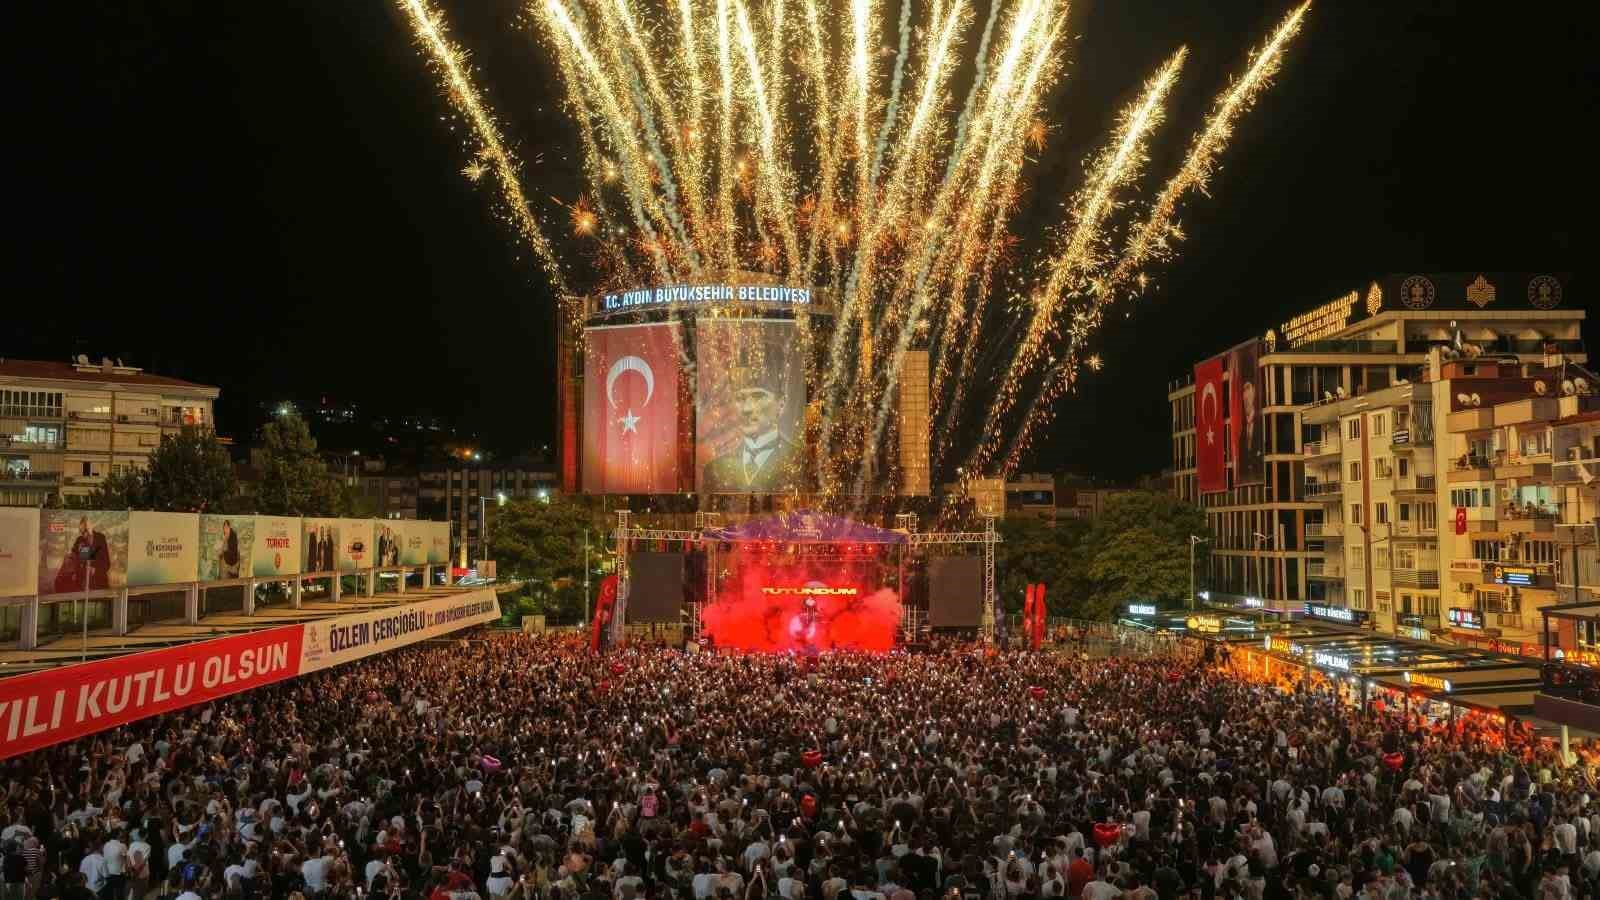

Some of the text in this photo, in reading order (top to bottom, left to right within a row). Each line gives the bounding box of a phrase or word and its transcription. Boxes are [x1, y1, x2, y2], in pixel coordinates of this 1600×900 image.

[605, 295, 621, 309] T.C.
[623, 289, 652, 306] AYDIN
[330, 622, 369, 653] ÖZLEM
[373, 608, 425, 646] ÇERÇİOĞLU
[75, 661, 196, 723] KUTLU
[202, 641, 289, 689] OLSUN
